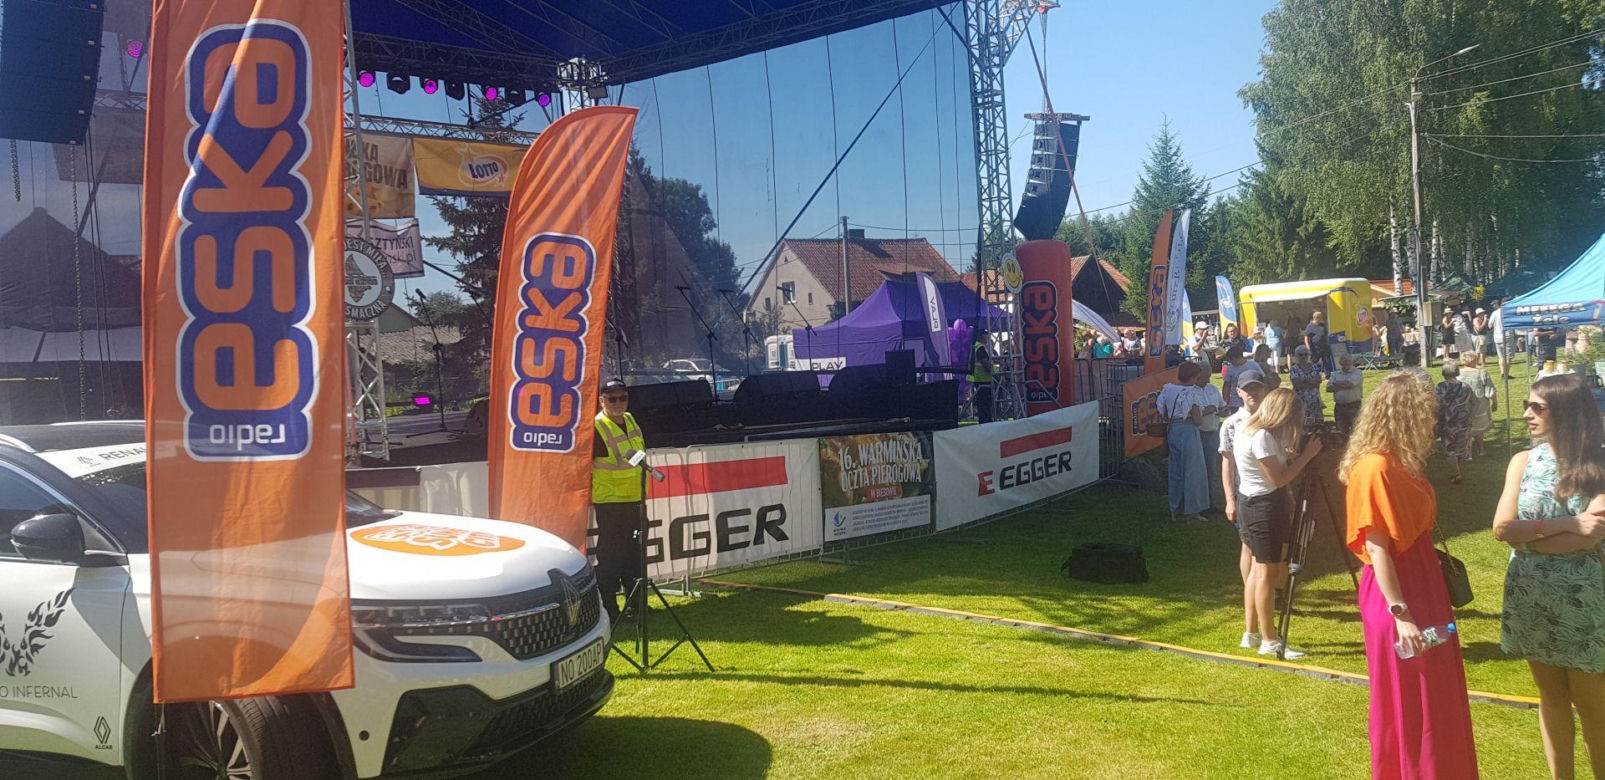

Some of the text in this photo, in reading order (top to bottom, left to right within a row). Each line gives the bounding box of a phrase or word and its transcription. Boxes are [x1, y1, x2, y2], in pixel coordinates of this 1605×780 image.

[468, 161, 499, 179] LOTTO
[194, 38, 299, 411] eska
[517, 241, 587, 428] eska
[1023, 285, 1057, 389] eska
[811, 361, 843, 371] PLAY
[209, 424, 286, 451] radio
[523, 431, 562, 447] radio
[100, 447, 145, 461] RENA
[838, 447, 856, 471] 16.
[872, 463, 922, 485] PIEROGOWA
[999, 450, 1073, 489] EGGER
[560, 643, 602, 686] NO 200AP
[12, 686, 79, 700] INFERNAL
